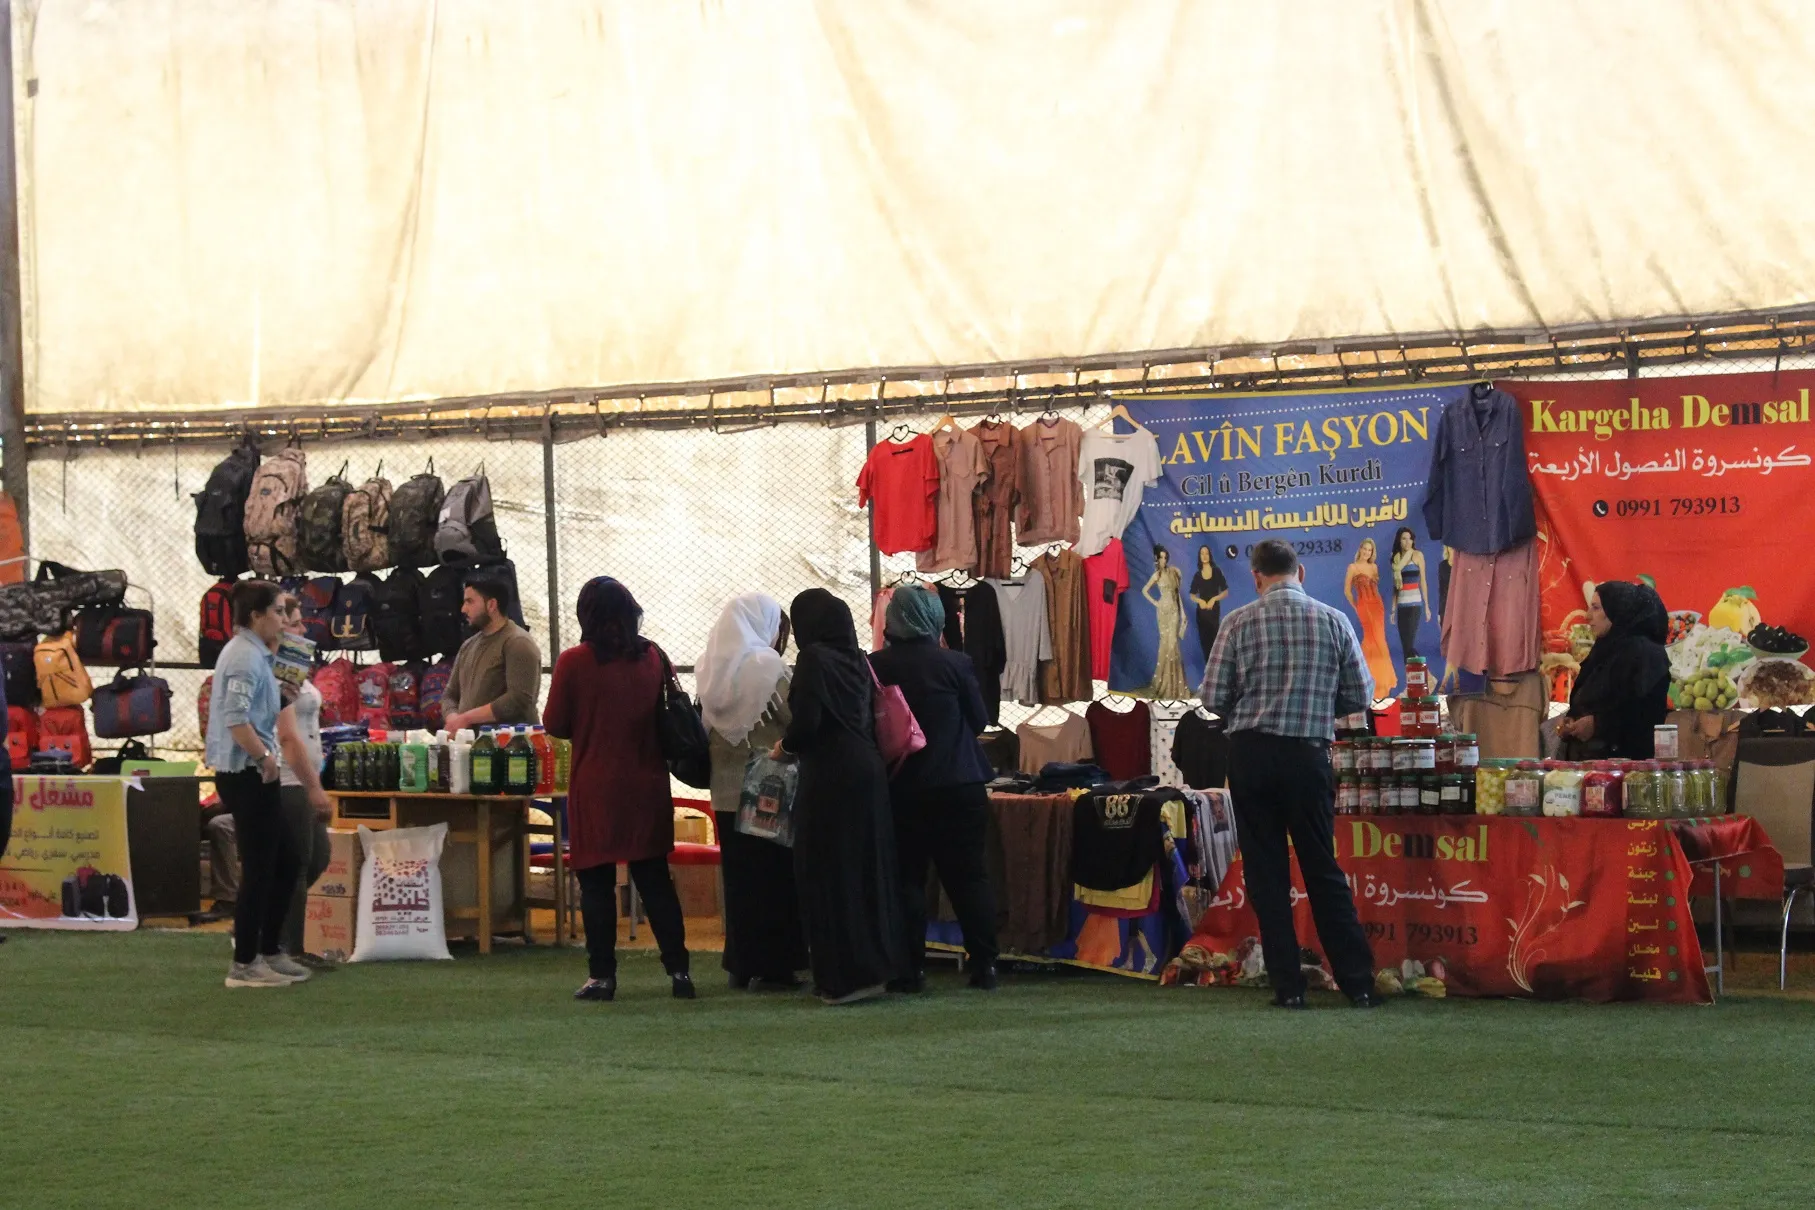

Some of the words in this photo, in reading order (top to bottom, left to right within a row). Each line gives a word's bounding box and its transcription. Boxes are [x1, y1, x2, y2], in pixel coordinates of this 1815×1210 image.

[1529, 398, 1671, 442] Kargeha
[1680, 389, 1810, 429] Demsal
[1274, 406, 1430, 462] FAŞYON
[1605, 448, 1687, 481] الفصول
[1692, 445, 1812, 477] كونسروة
[1181, 475, 1213, 497] Cil
[1219, 476, 1231, 494] û
[1238, 469, 1312, 497] Bergên
[1319, 459, 1384, 485] Kurdî
[1615, 499, 1662, 518] 0991
[1671, 496, 1741, 517] 793913
[1170, 509, 1260, 539] النسائية
[1290, 539, 1343, 556] 29338
[1350, 821, 1489, 864] Demsal
[1627, 865, 1657, 882] جبنة
[1364, 874, 1489, 909] كونسروة
[1364, 921, 1396, 942] 991
[1406, 922, 1479, 945] 793913
